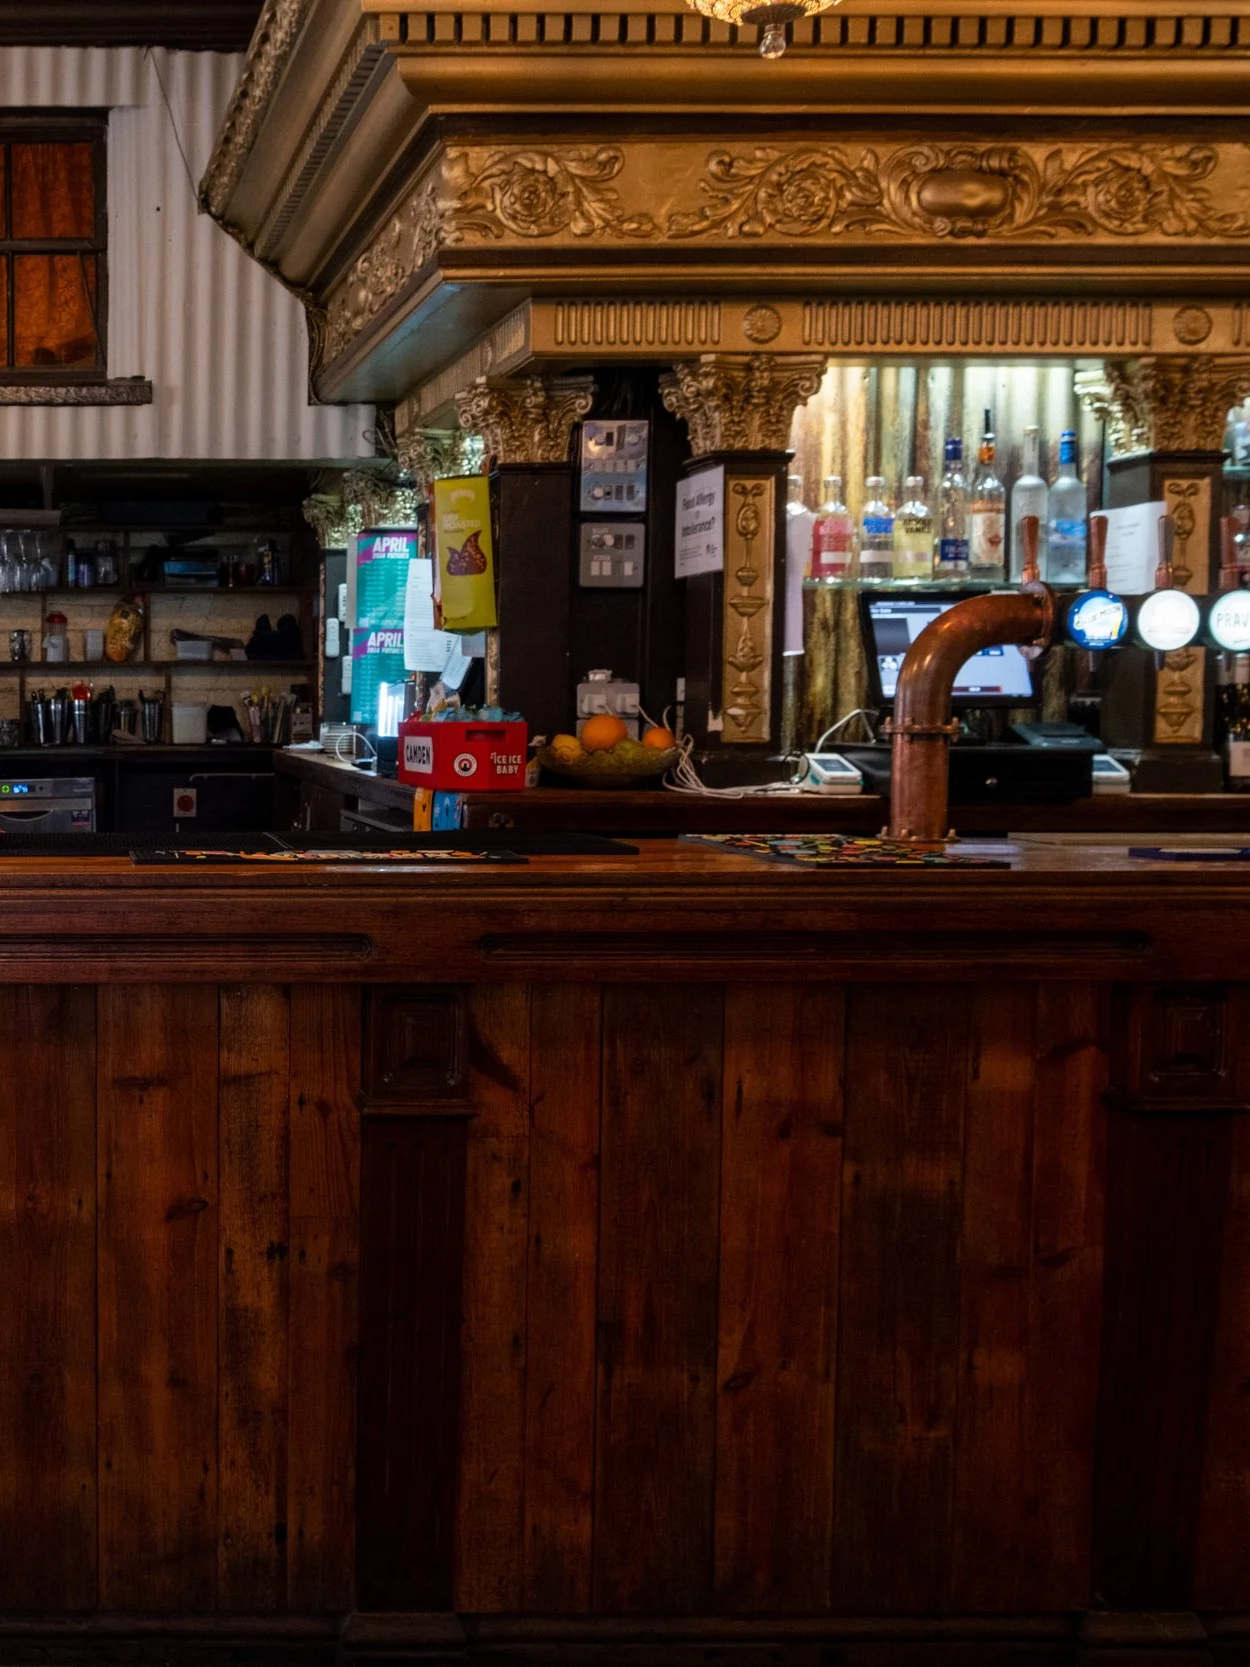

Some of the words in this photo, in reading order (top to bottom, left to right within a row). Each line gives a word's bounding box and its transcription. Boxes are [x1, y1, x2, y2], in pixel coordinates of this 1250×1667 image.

[372, 536, 410, 552] APRIL
[366, 631, 405, 648] APRIL
[406, 743, 432, 766] CAMDEN
[508, 755, 523, 765] ICE
[496, 764, 519, 775] BABY
